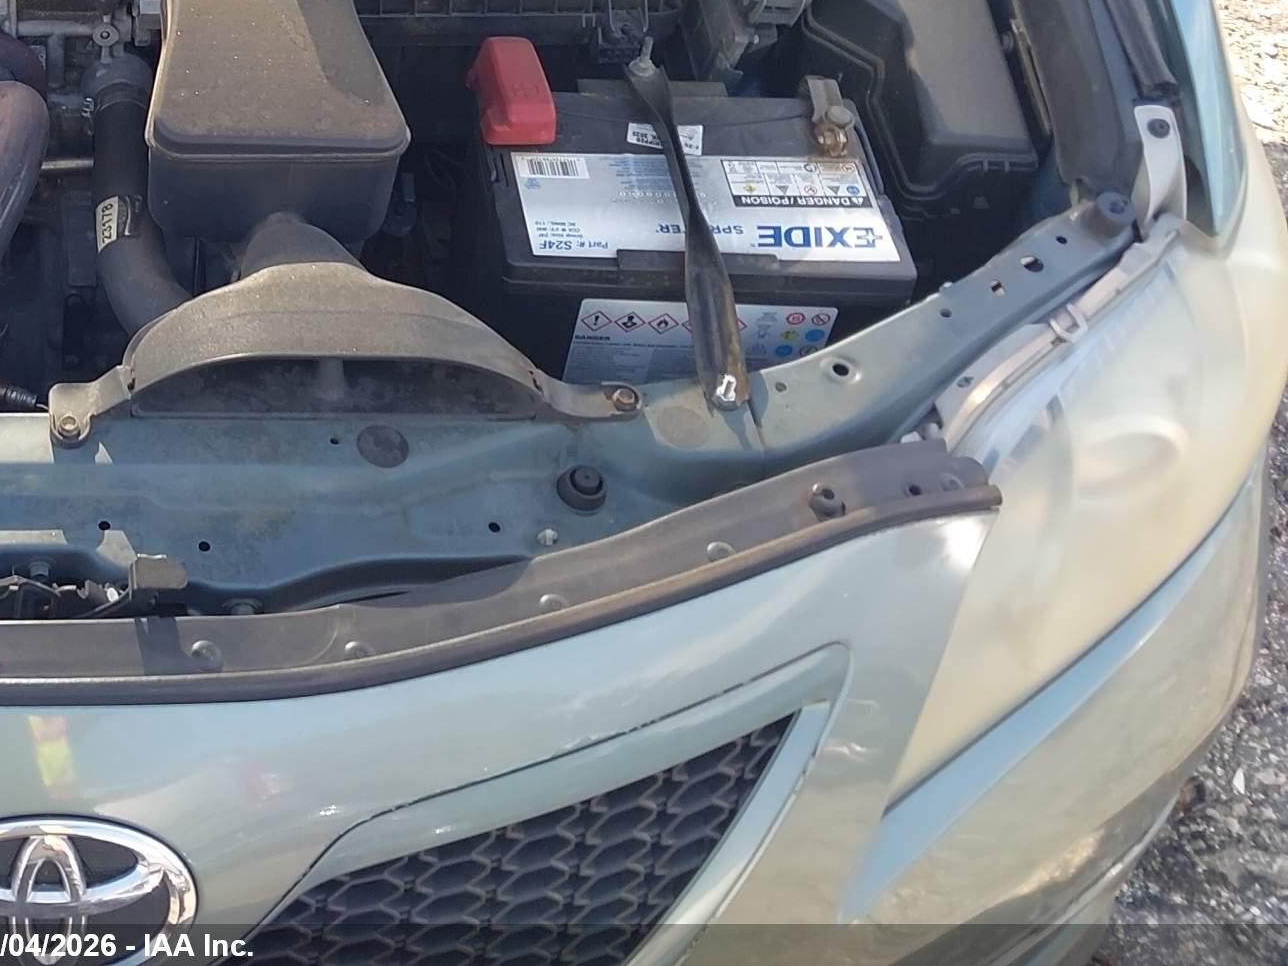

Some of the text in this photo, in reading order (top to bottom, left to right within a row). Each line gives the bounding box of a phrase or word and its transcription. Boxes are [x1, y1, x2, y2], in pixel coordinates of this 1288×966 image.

[740, 196, 788, 205] POISON
[796, 196, 851, 206] DANGER
[101, 202, 114, 244] 23178
[658, 223, 744, 235] SPRER
[756, 225, 882, 249] EXIDE
[539, 240, 573, 250] S24F
[588, 241, 609, 250] Part
